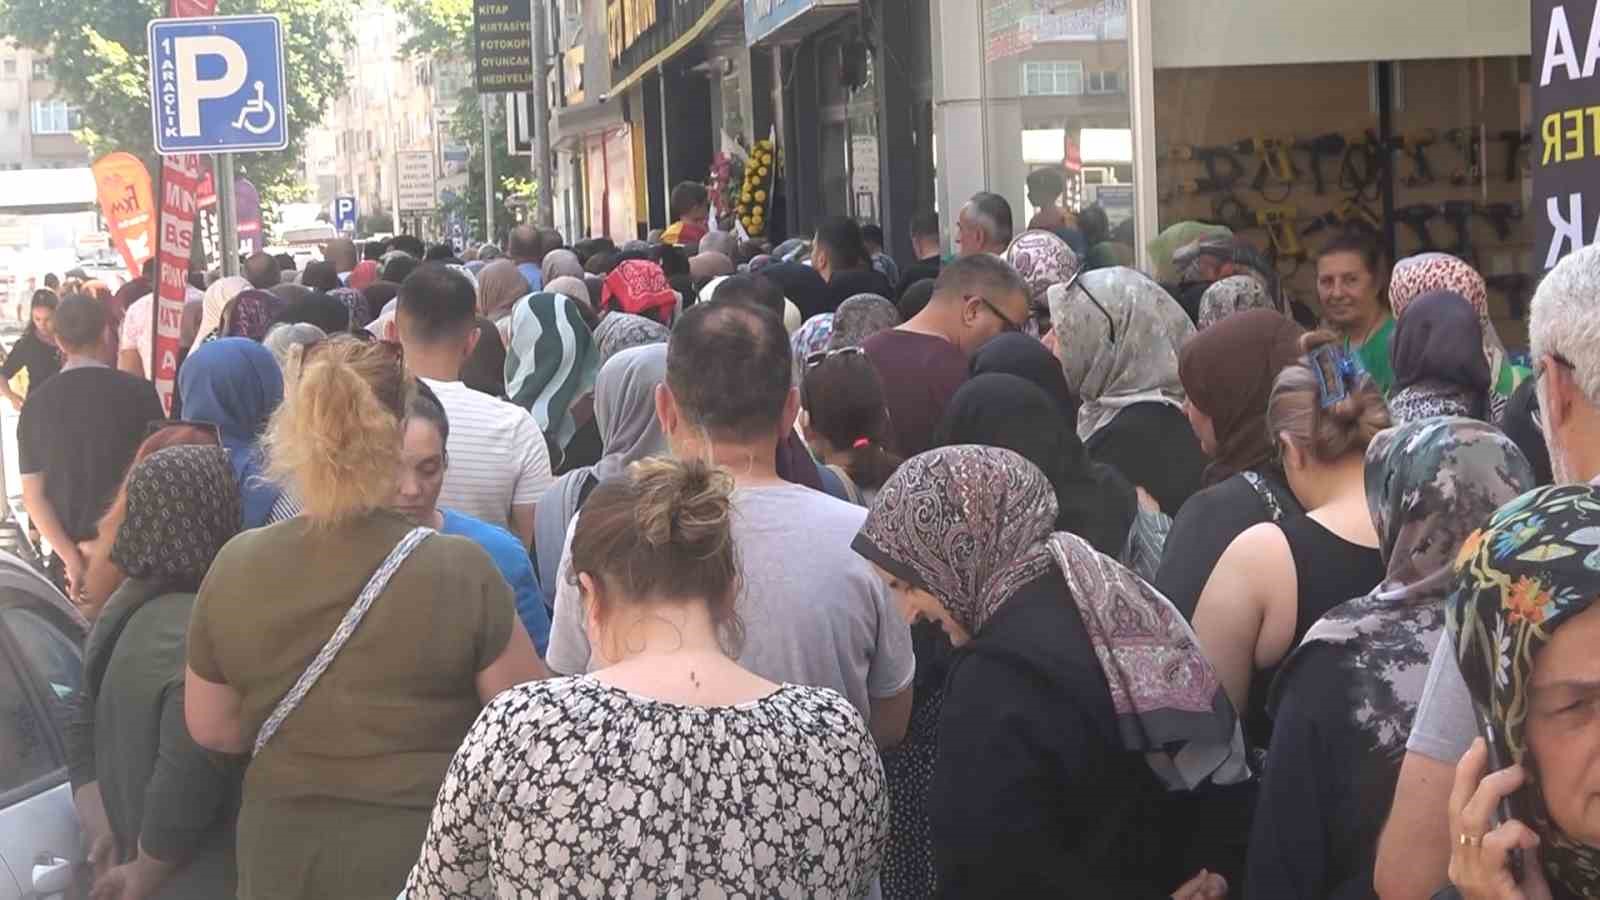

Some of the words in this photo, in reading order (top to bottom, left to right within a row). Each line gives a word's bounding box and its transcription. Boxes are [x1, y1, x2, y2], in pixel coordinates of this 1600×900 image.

[161, 38, 171, 55] 1
[175, 35, 248, 137] P
[339, 199, 353, 220] P
